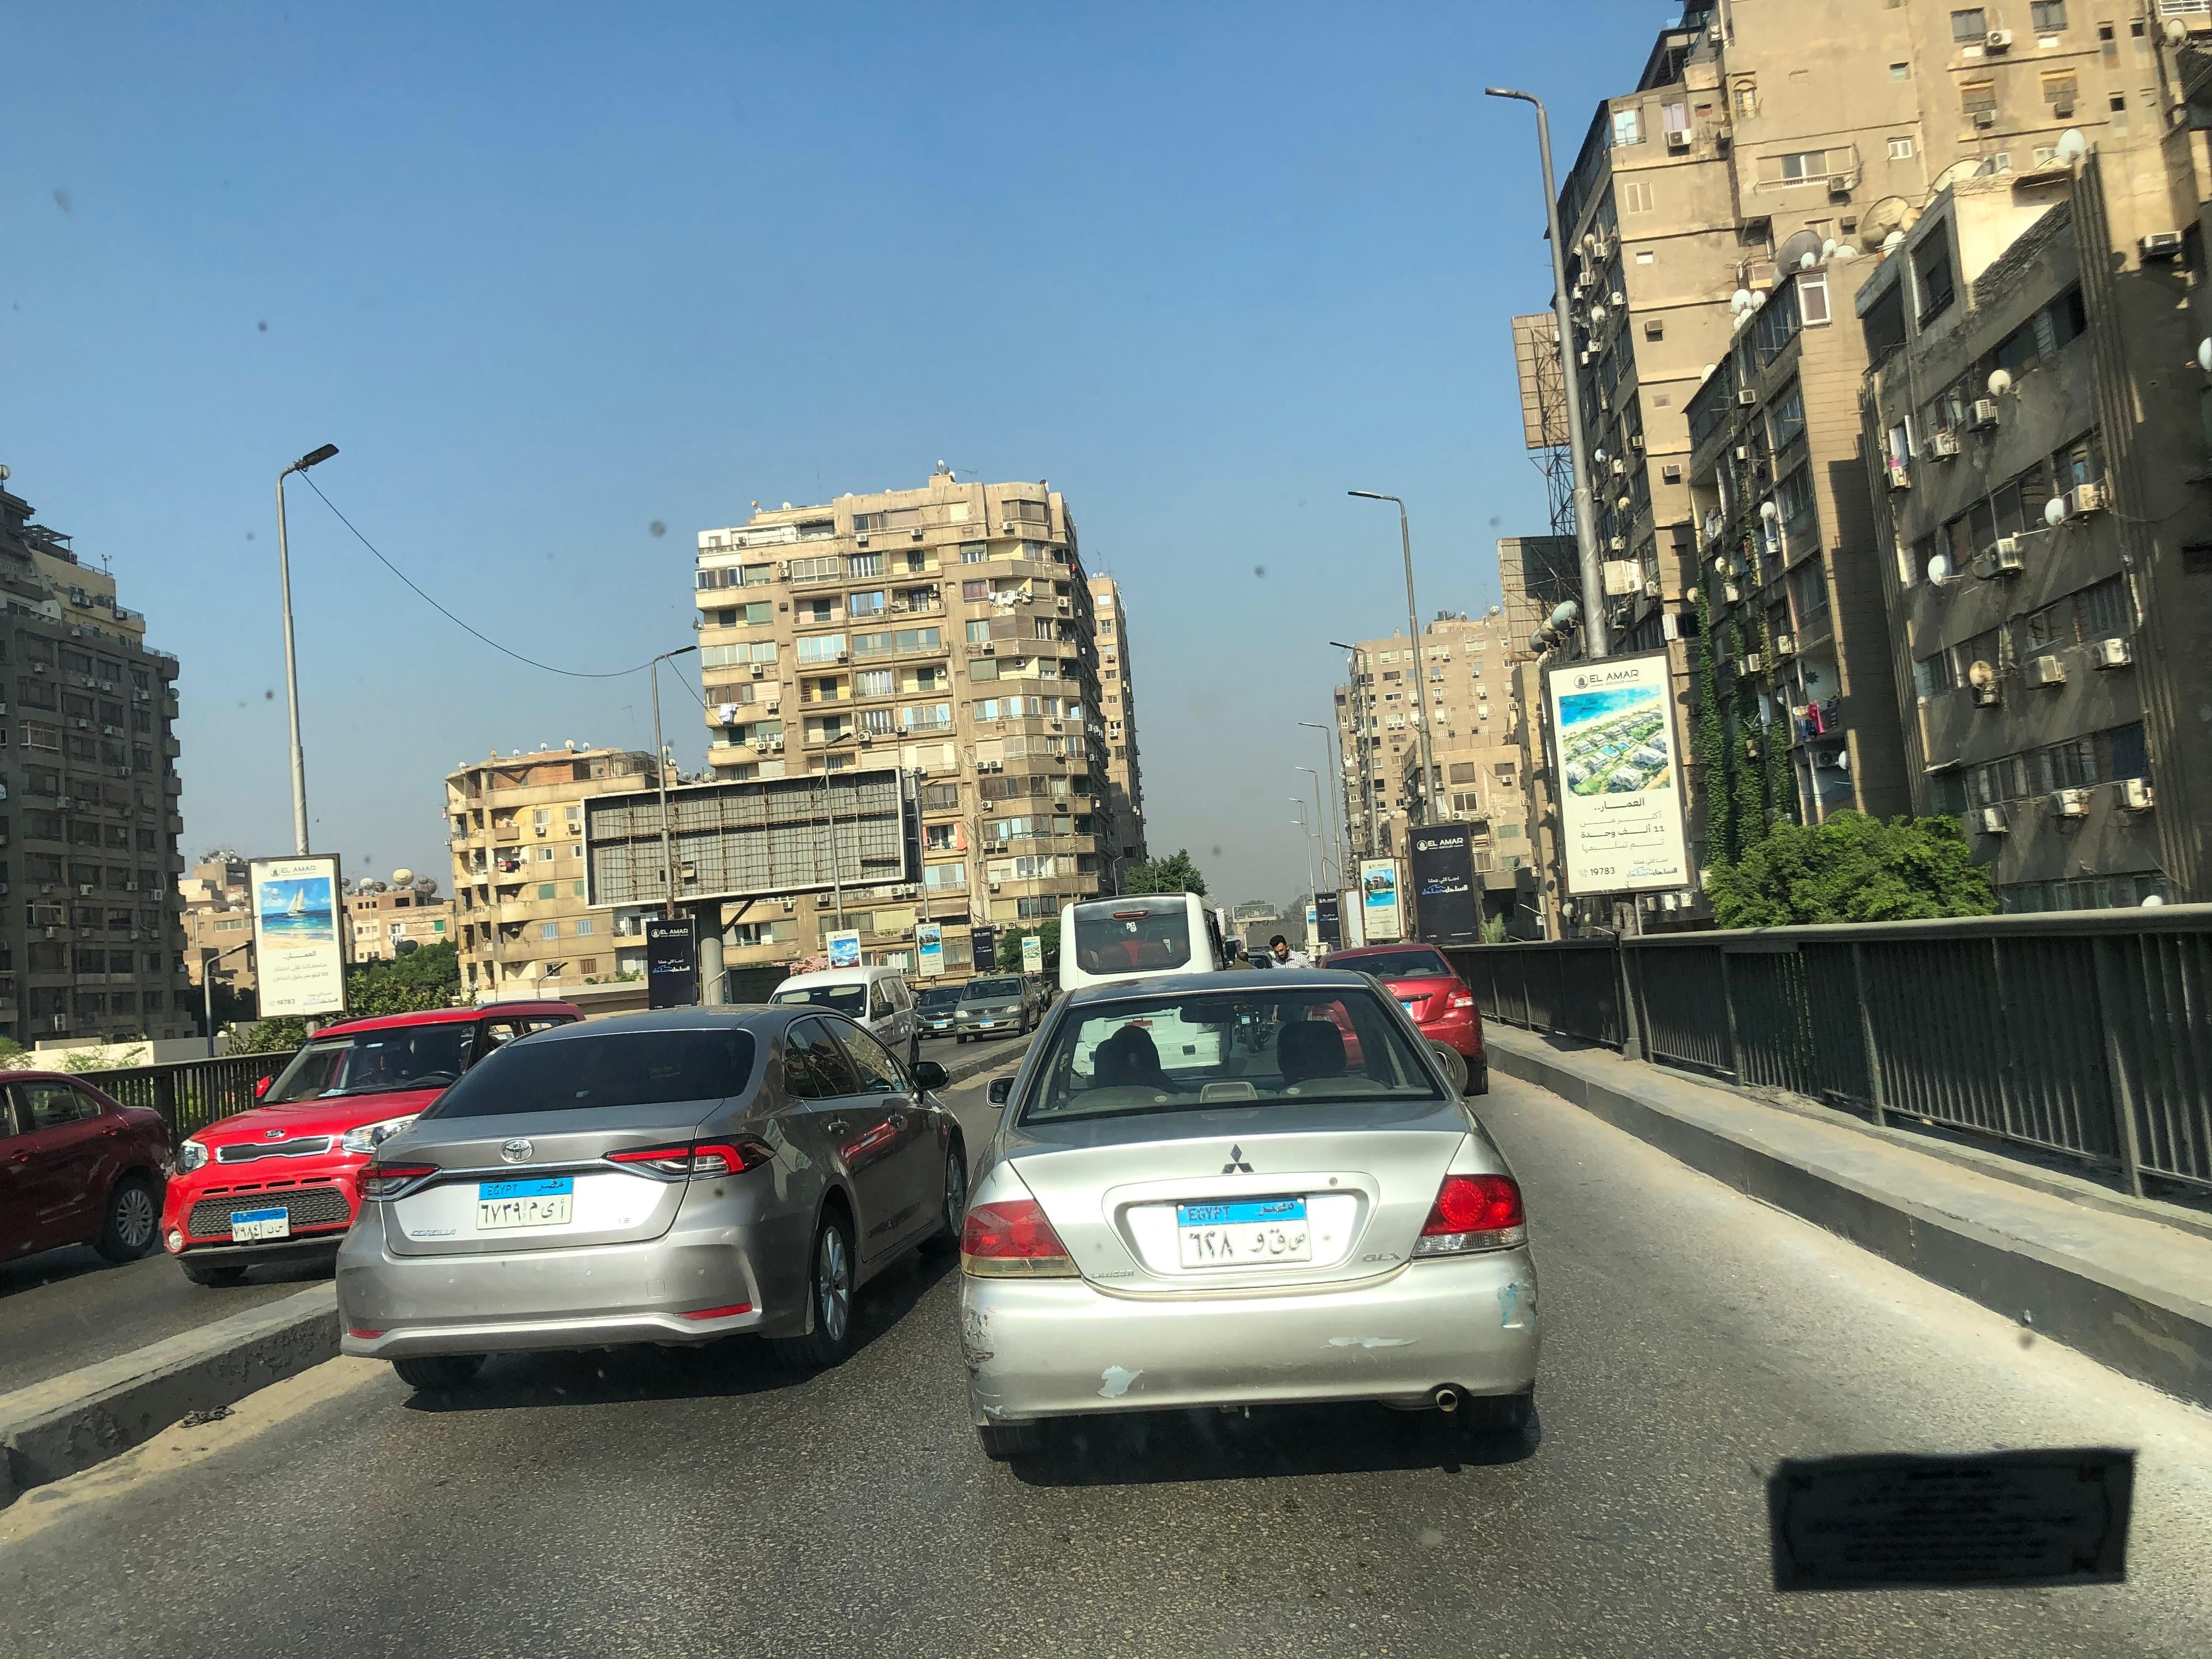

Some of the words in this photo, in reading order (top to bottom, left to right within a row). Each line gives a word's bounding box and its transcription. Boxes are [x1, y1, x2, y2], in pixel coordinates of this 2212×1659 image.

[1589, 674, 1603, 682] EL
[1606, 669, 1639, 681] AMAR
[1579, 819, 1616, 827] من
[1618, 824, 1651, 835] ألف
[1440, 837, 1464, 845] AMAR
[1630, 839, 1664, 850] تم
[1582, 841, 1628, 853] تسليمها
[1590, 867, 1615, 876] 19783
[487, 1183, 517, 1195] EGYPT
[536, 1179, 564, 1192] مصر
[1188, 1205, 1230, 1221] EGYPT
[1255, 1202, 1294, 1216] مصر
[1091, 1269, 1133, 1278] LANCER
